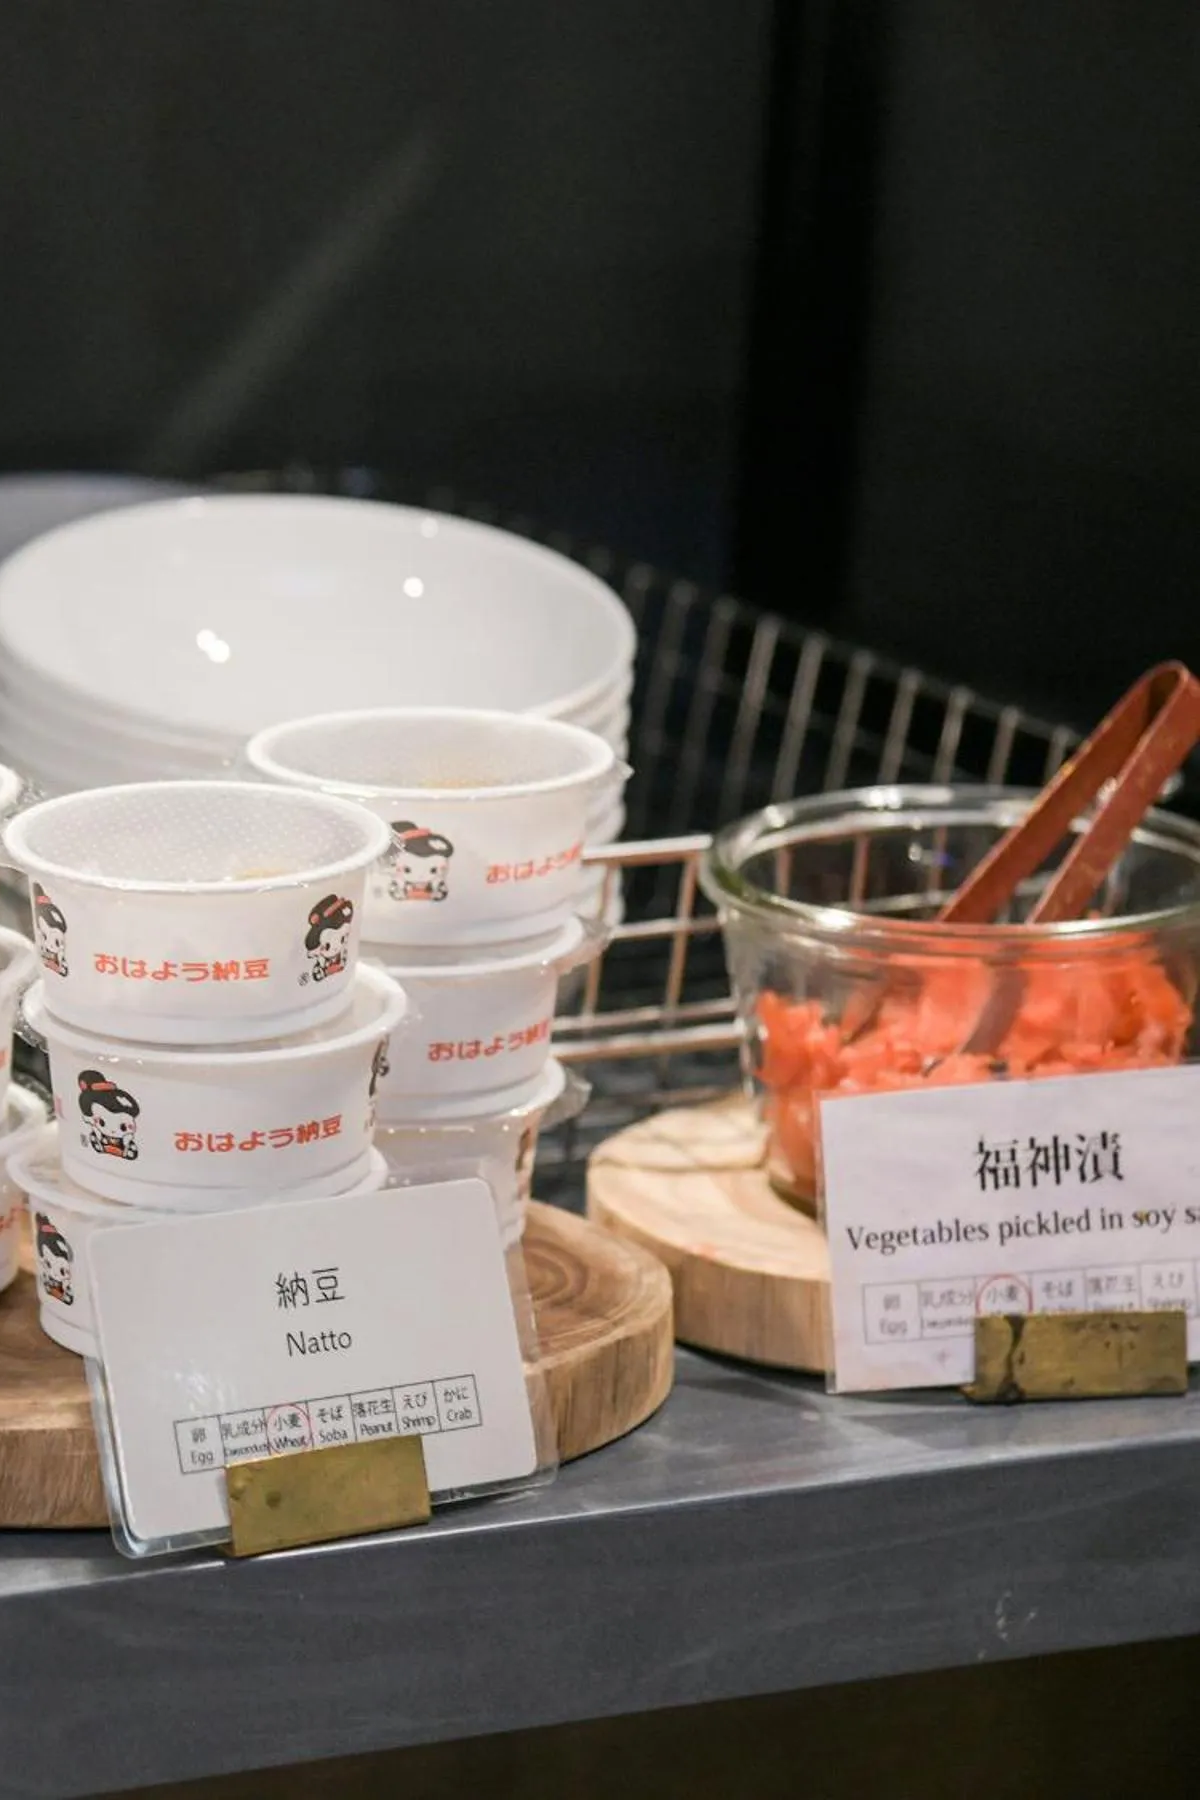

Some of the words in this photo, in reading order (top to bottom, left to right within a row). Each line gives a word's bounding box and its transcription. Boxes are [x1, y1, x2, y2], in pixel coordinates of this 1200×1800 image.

[94, 953, 271, 982] おはよう納豆
[174, 1114, 343, 1153] おはよう納豆
[975, 1130, 1125, 1192] 福神漬
[846, 1217, 990, 1256] Vegetables
[999, 1208, 1092, 1246] pickled
[1100, 1207, 1124, 1231] in
[1132, 1207, 1176, 1234] soy
[276, 1267, 346, 1309] 納豆
[287, 1330, 353, 1357] Natto
[319, 1429, 349, 1444] Soba
[402, 1414, 437, 1430] Shrimp
[446, 1407, 473, 1422] Crab
